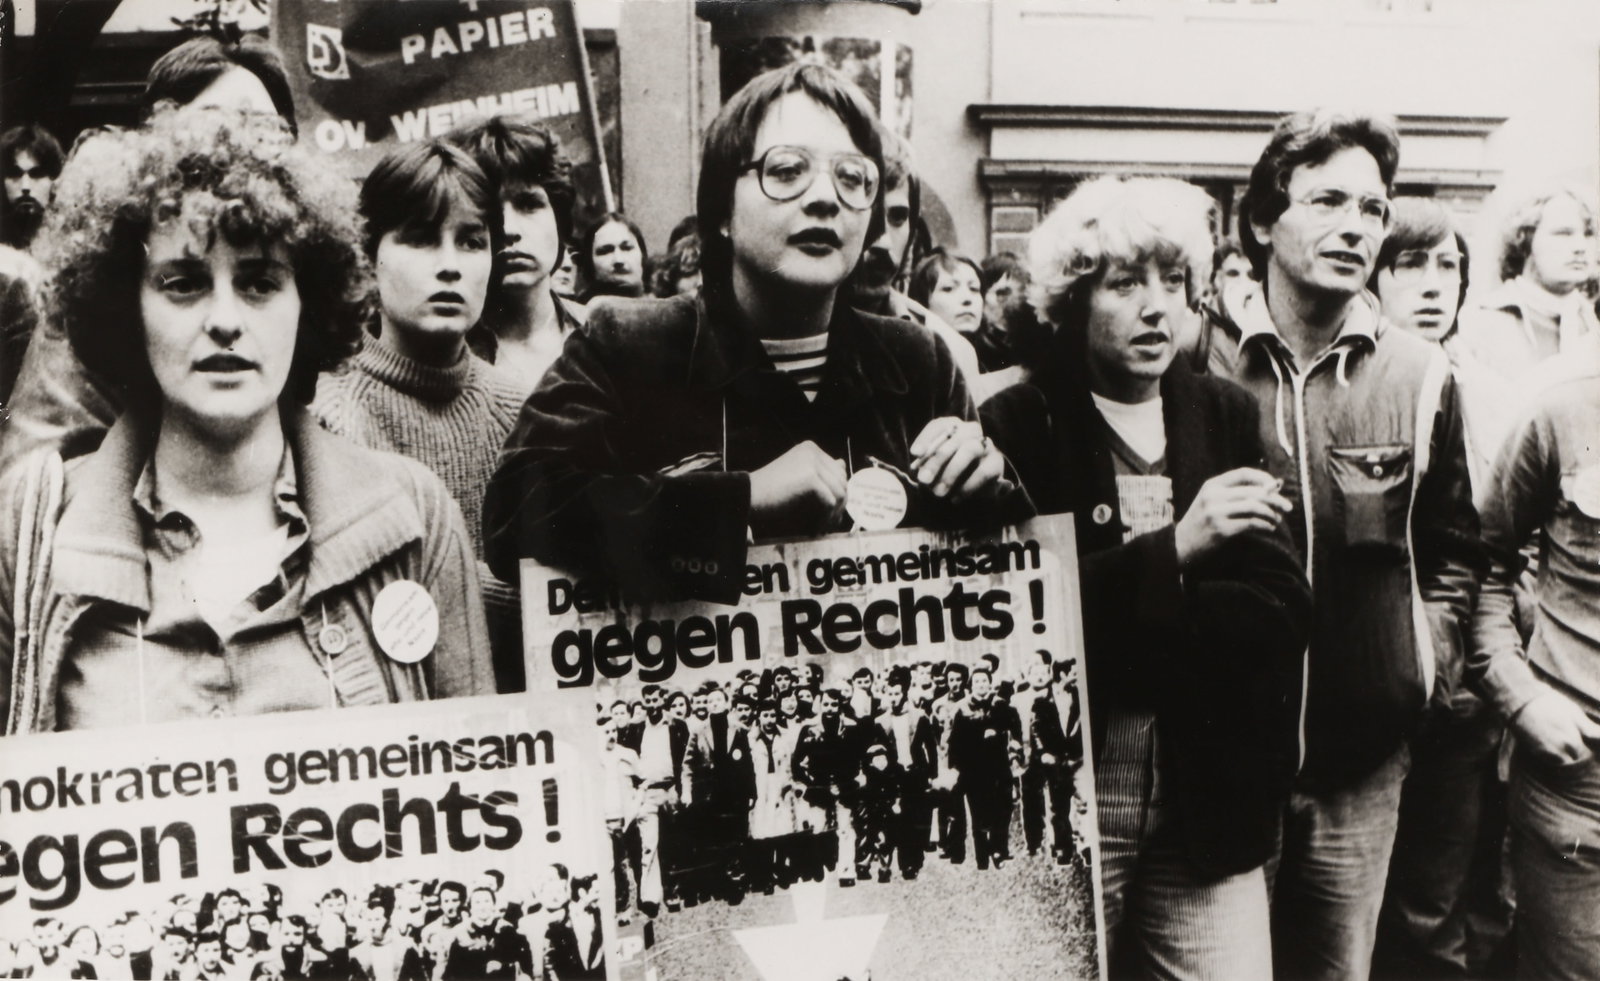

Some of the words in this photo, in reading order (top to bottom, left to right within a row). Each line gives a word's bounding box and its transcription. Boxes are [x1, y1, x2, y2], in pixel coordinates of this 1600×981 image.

[401, 7, 556, 64] PAPIER
[390, 81, 580, 143] WEINHEIM
[806, 539, 1040, 595] gemeinsam
[551, 611, 761, 689] gegen
[780, 582, 1015, 657] Rechts
[1028, 578, 1047, 635] !
[264, 729, 555, 795] gemeinsam
[229, 781, 523, 874] Rechts
[541, 777, 562, 843] !
